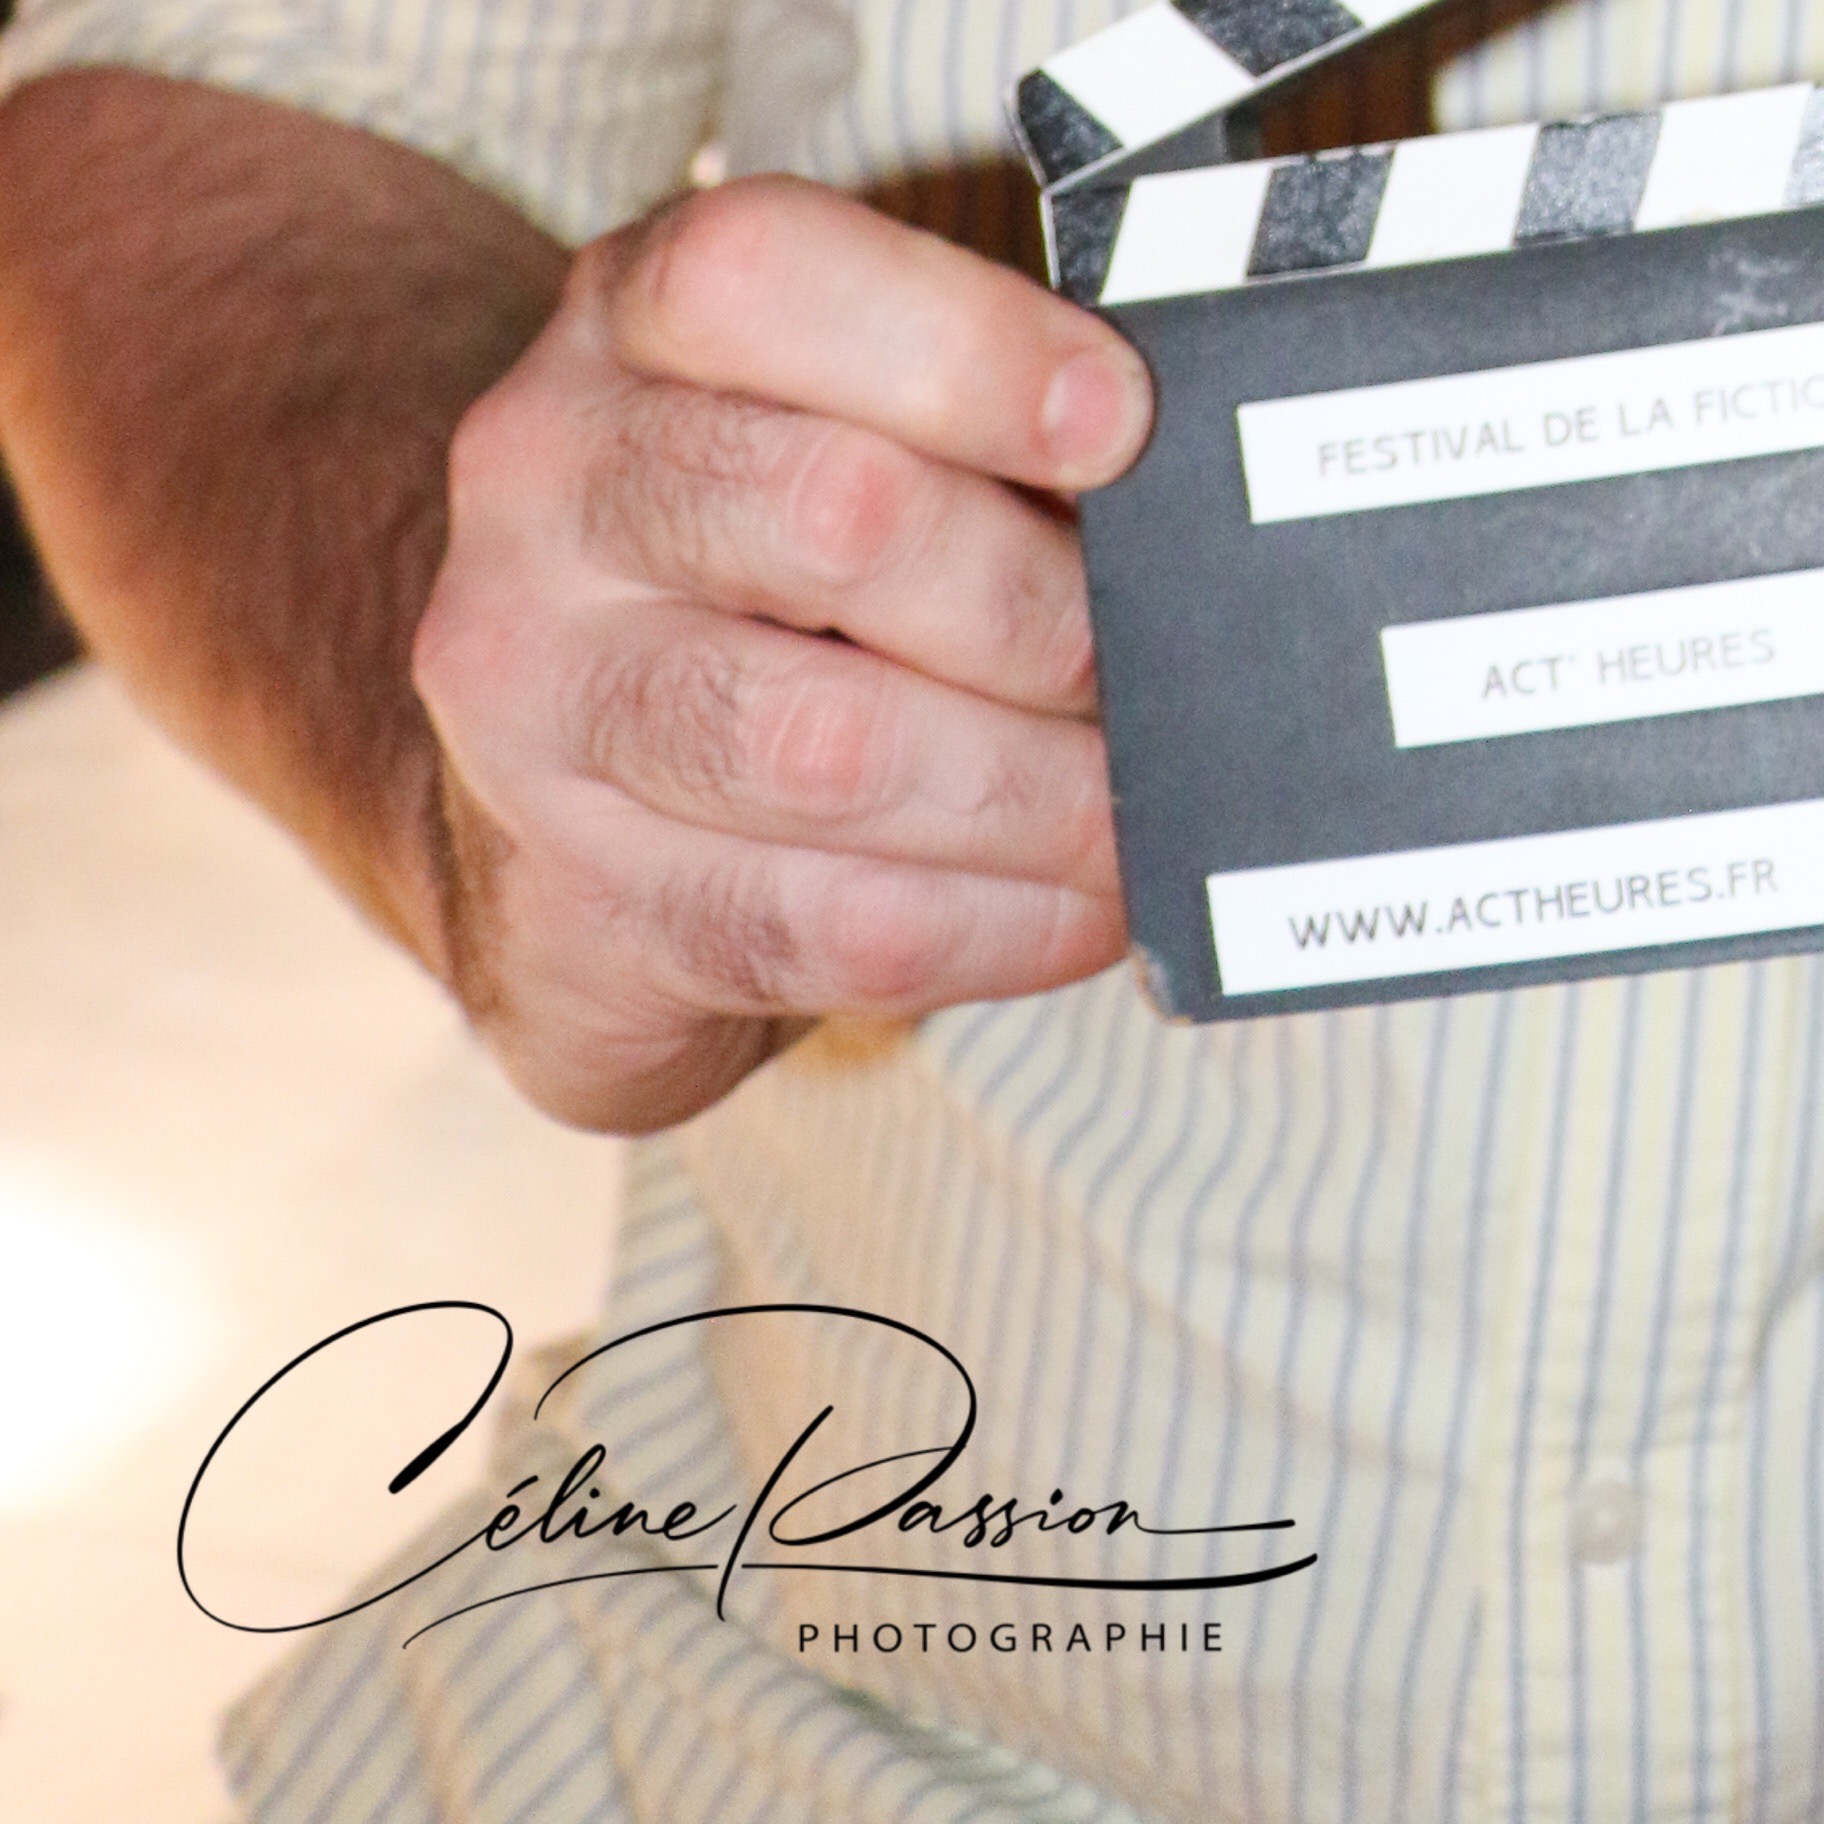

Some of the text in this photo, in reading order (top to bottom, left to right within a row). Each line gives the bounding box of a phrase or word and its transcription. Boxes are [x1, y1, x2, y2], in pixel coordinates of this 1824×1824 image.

[1316, 417, 1524, 478] FESTIVAL
[1543, 407, 1600, 446] DE
[1619, 395, 1674, 436] LA
[1598, 628, 1775, 685] HEURES
[1288, 858, 1778, 950] WWW.ACTHEURES.FR
